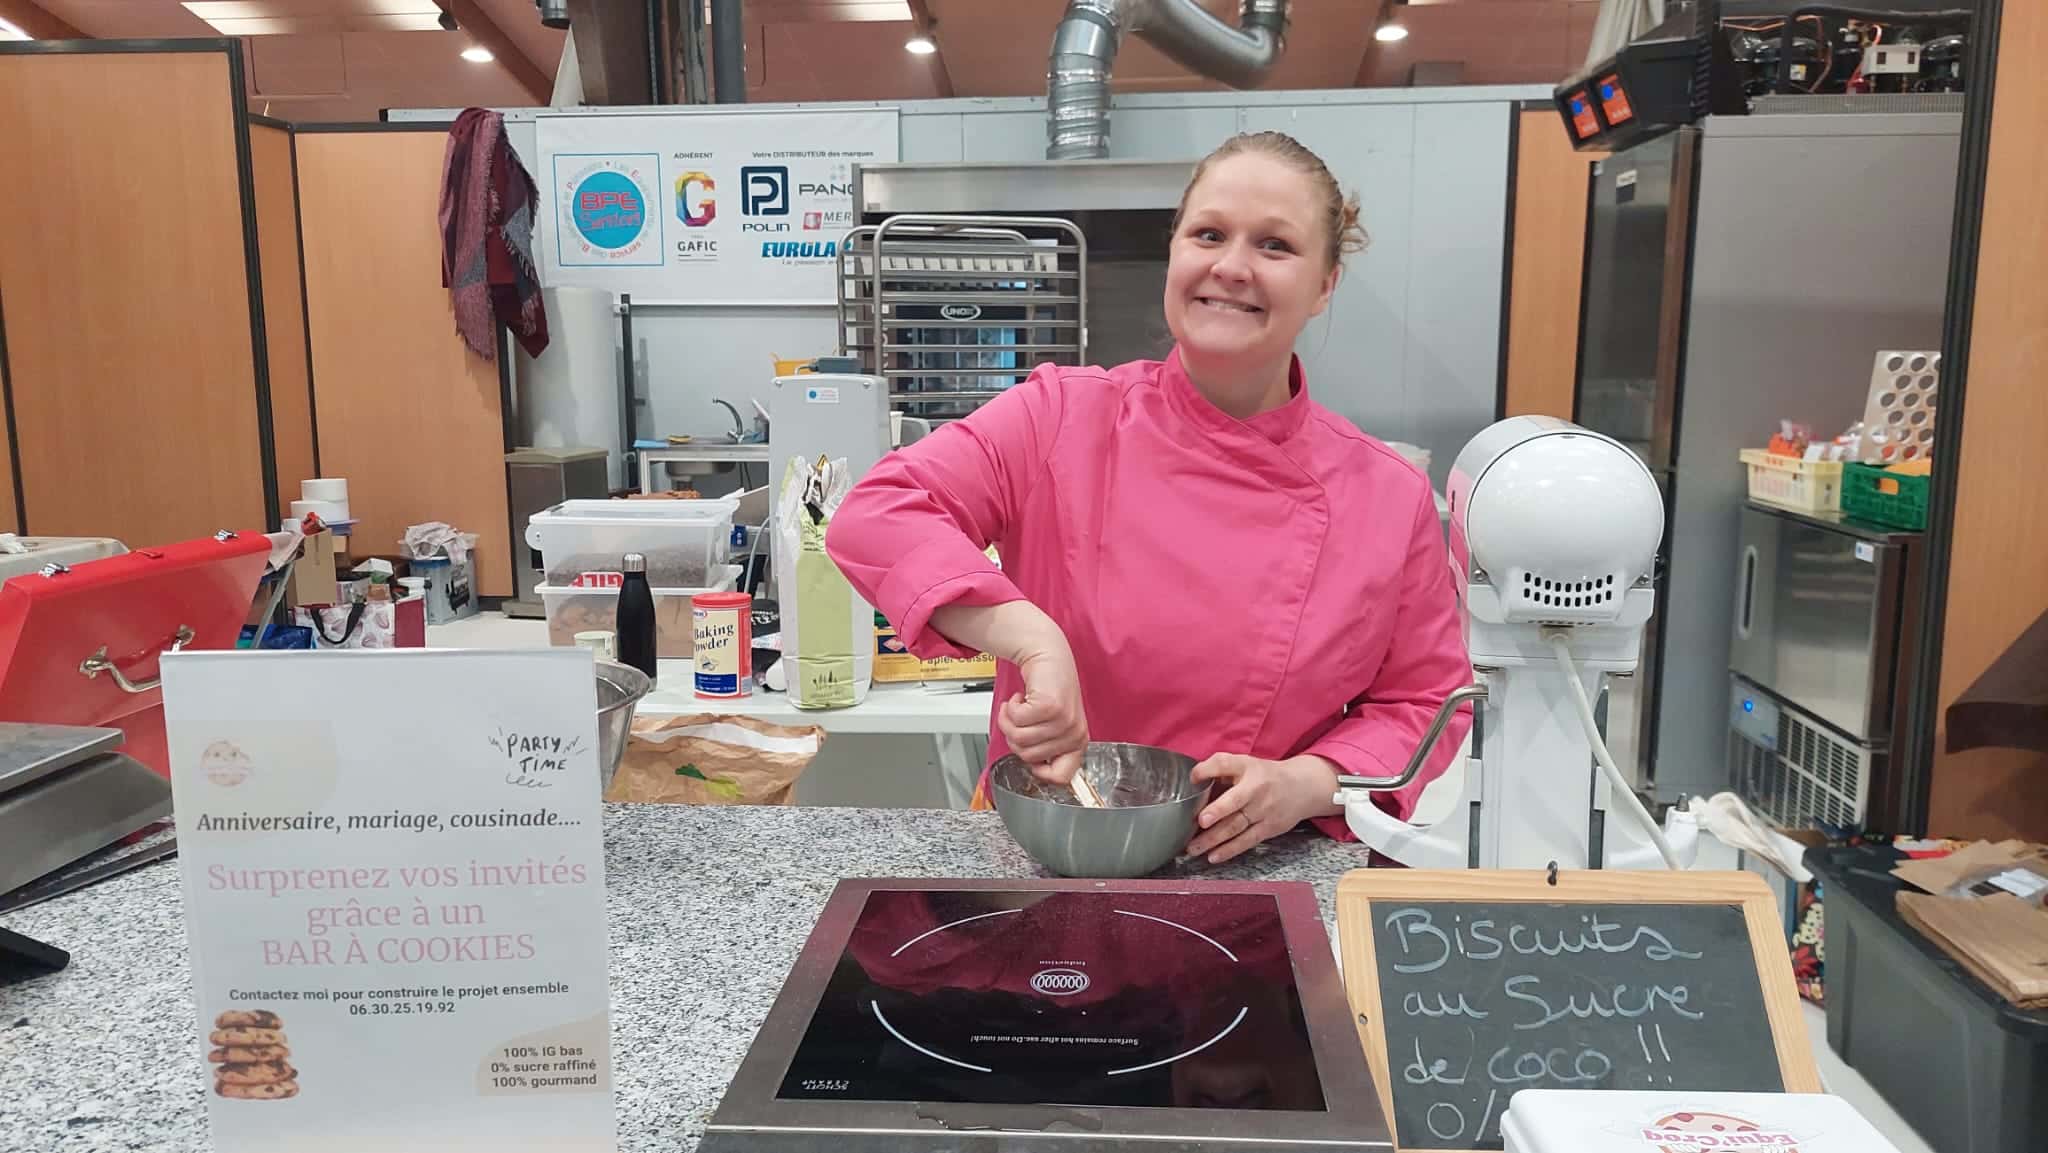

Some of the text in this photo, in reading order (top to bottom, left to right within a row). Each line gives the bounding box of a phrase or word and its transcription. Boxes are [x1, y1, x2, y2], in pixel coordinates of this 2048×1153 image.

[677, 241, 717, 251] GAFIC
[694, 637, 729, 652] owder
[507, 733, 561, 758] PARTY
[520, 756, 567, 773] TIME
[197, 808, 581, 834] Anniversaire, mariage, cousinade....
[208, 855, 588, 898] Surprenez vos invités
[307, 897, 486, 936] grâce à un
[261, 933, 536, 966] BAR À COOKIES
[1385, 907, 1703, 973] Biscuits
[229, 982, 569, 1002] Contactez moi pour construire le projet ensemble
[349, 1001, 456, 1016] 06.30.25.19.92
[1403, 974, 1704, 1031] au Sucre
[1108, 1037, 1139, 1045] Surface
[503, 1045, 583, 1059] 100% IG bas
[1404, 1035, 1466, 1085] de
[490, 1058, 597, 1074] 0% sucre raffiné
[492, 1074, 597, 1089] 100% gourmand
[1643, 1128, 1799, 1146] Equi'Croq
